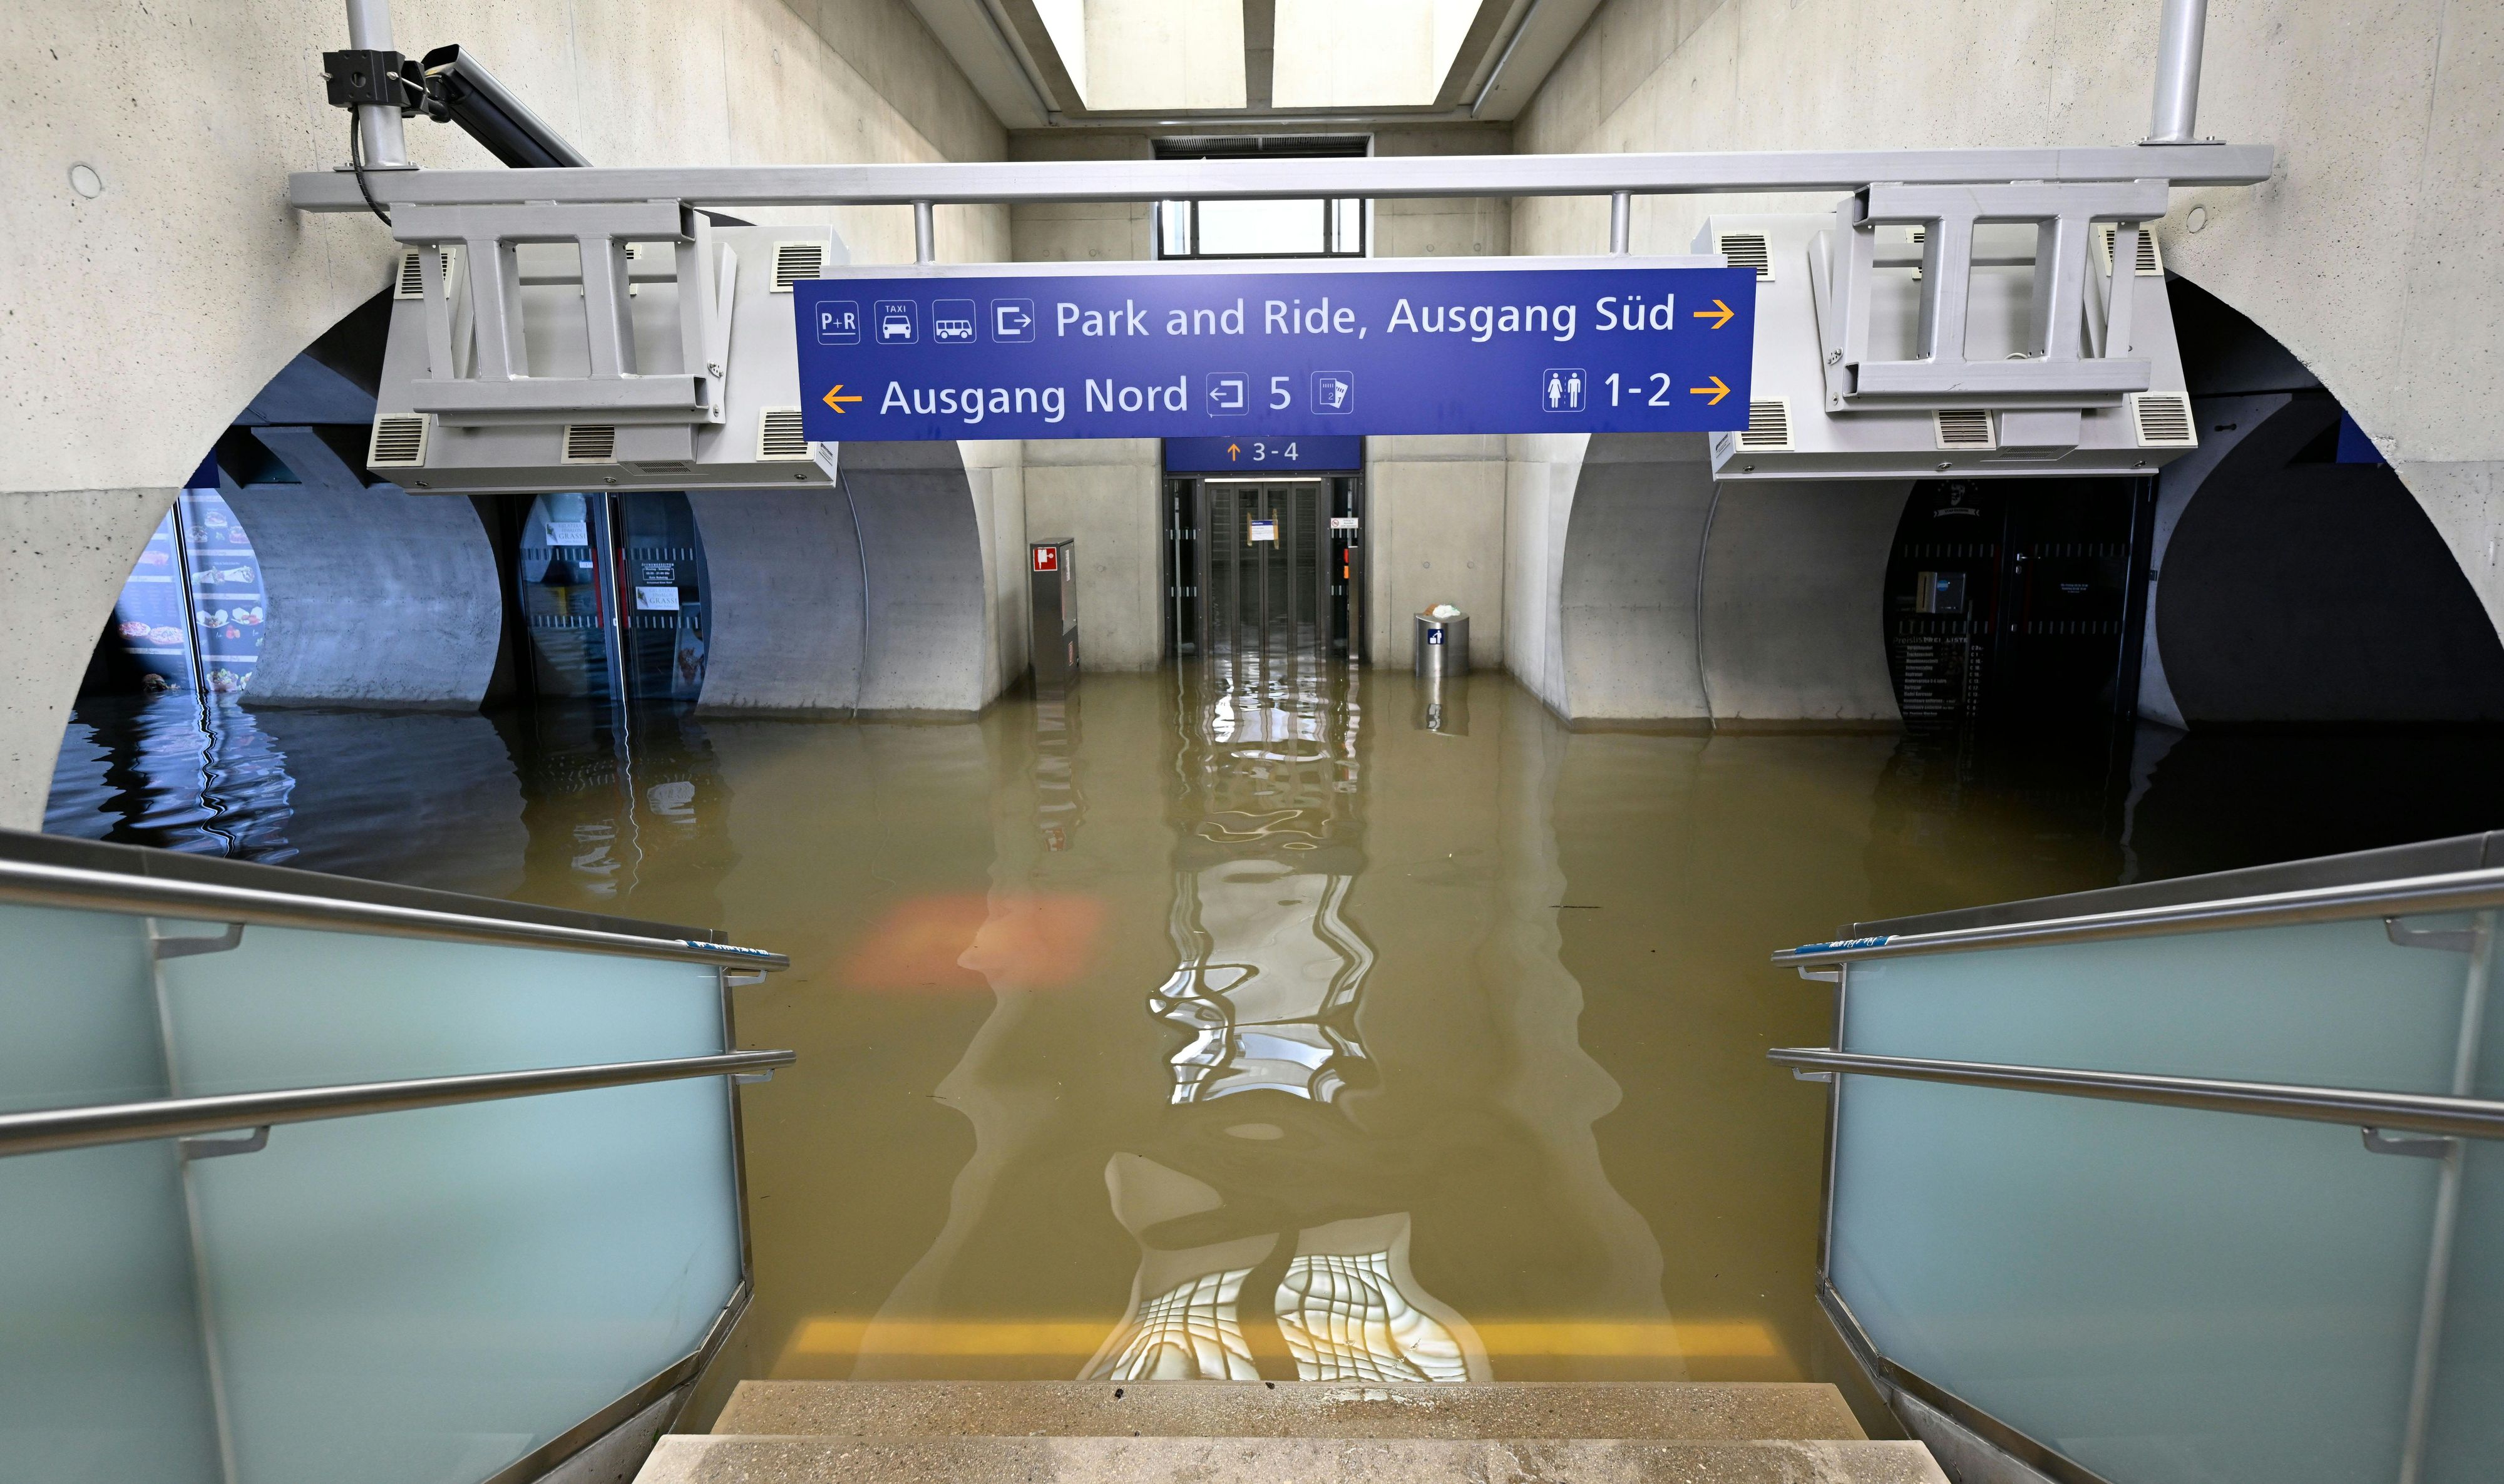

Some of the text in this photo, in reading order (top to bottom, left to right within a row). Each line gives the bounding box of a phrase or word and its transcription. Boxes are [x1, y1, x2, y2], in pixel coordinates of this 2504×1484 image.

[822, 314, 856, 330] P+R
[885, 305, 906, 313] TAXI
[1057, 294, 1674, 342] Park and Ride, Ausgang Süd
[880, 375, 1291, 424] Ausgang Nord 5
[1605, 372, 1670, 406] 1-2
